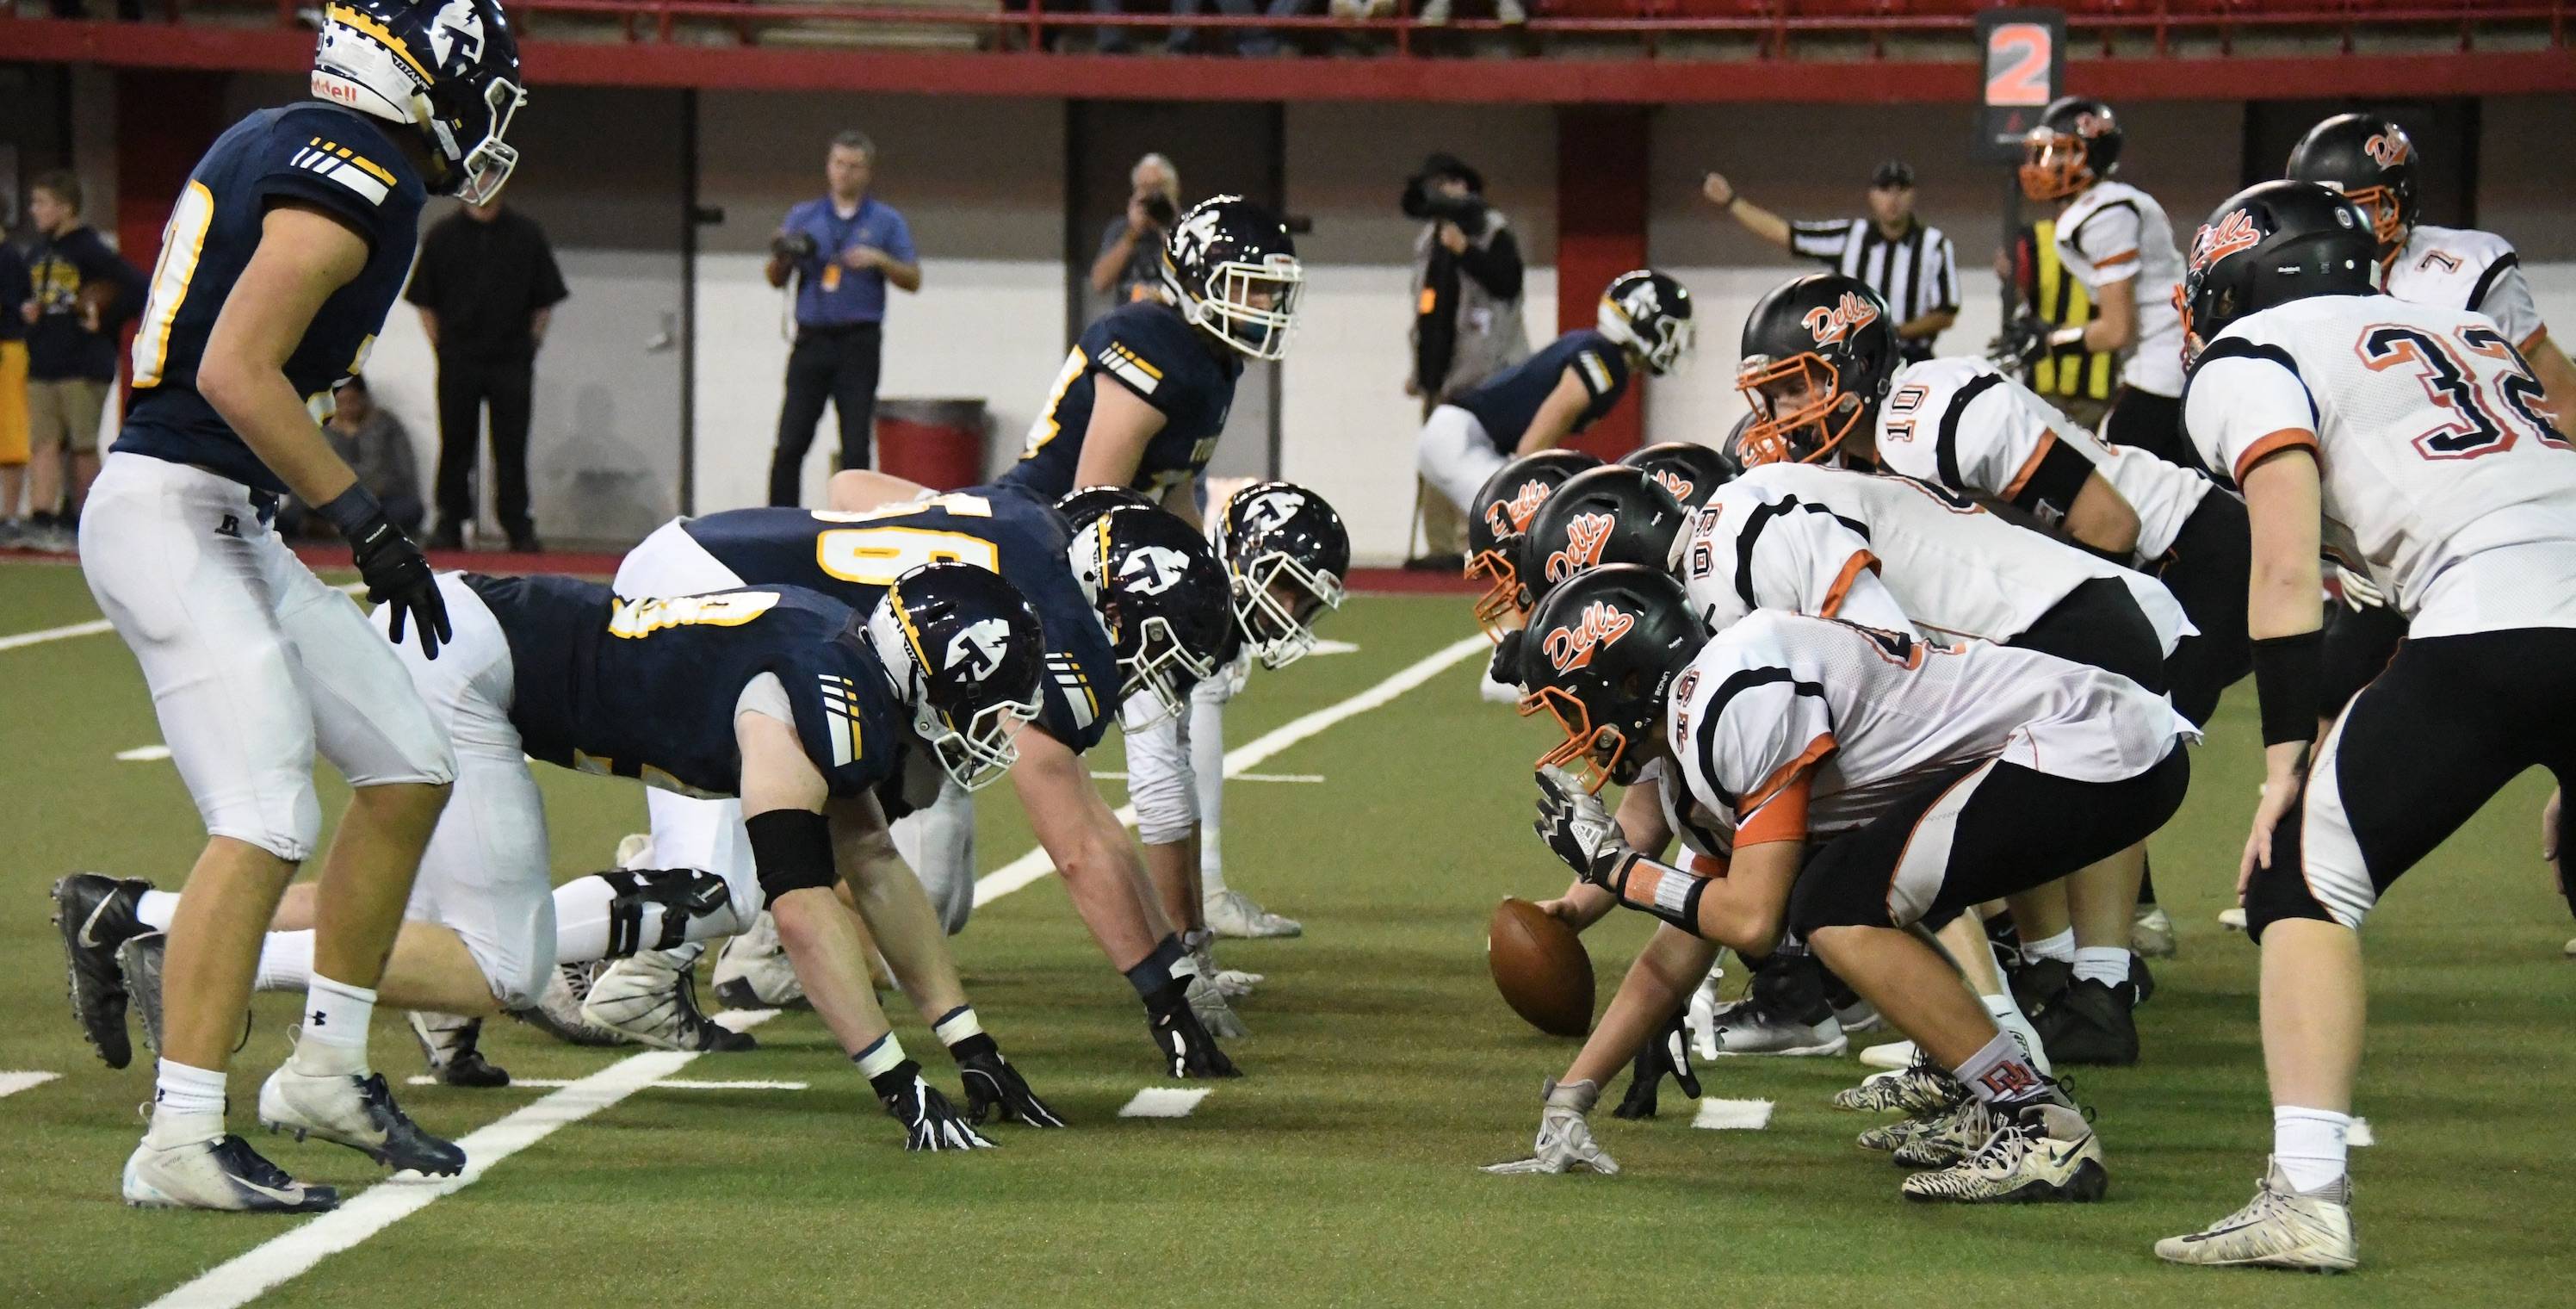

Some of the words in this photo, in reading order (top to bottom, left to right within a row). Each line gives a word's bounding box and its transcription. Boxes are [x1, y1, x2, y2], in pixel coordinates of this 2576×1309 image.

[1985, 22, 2053, 107] 2
[2414, 249, 2463, 273] 7
[1801, 291, 1879, 349] Dells
[1886, 385, 1929, 443] 10
[2354, 322, 2576, 462] 32
[1545, 512, 1615, 584] Dells
[1543, 600, 1635, 678] Dells
